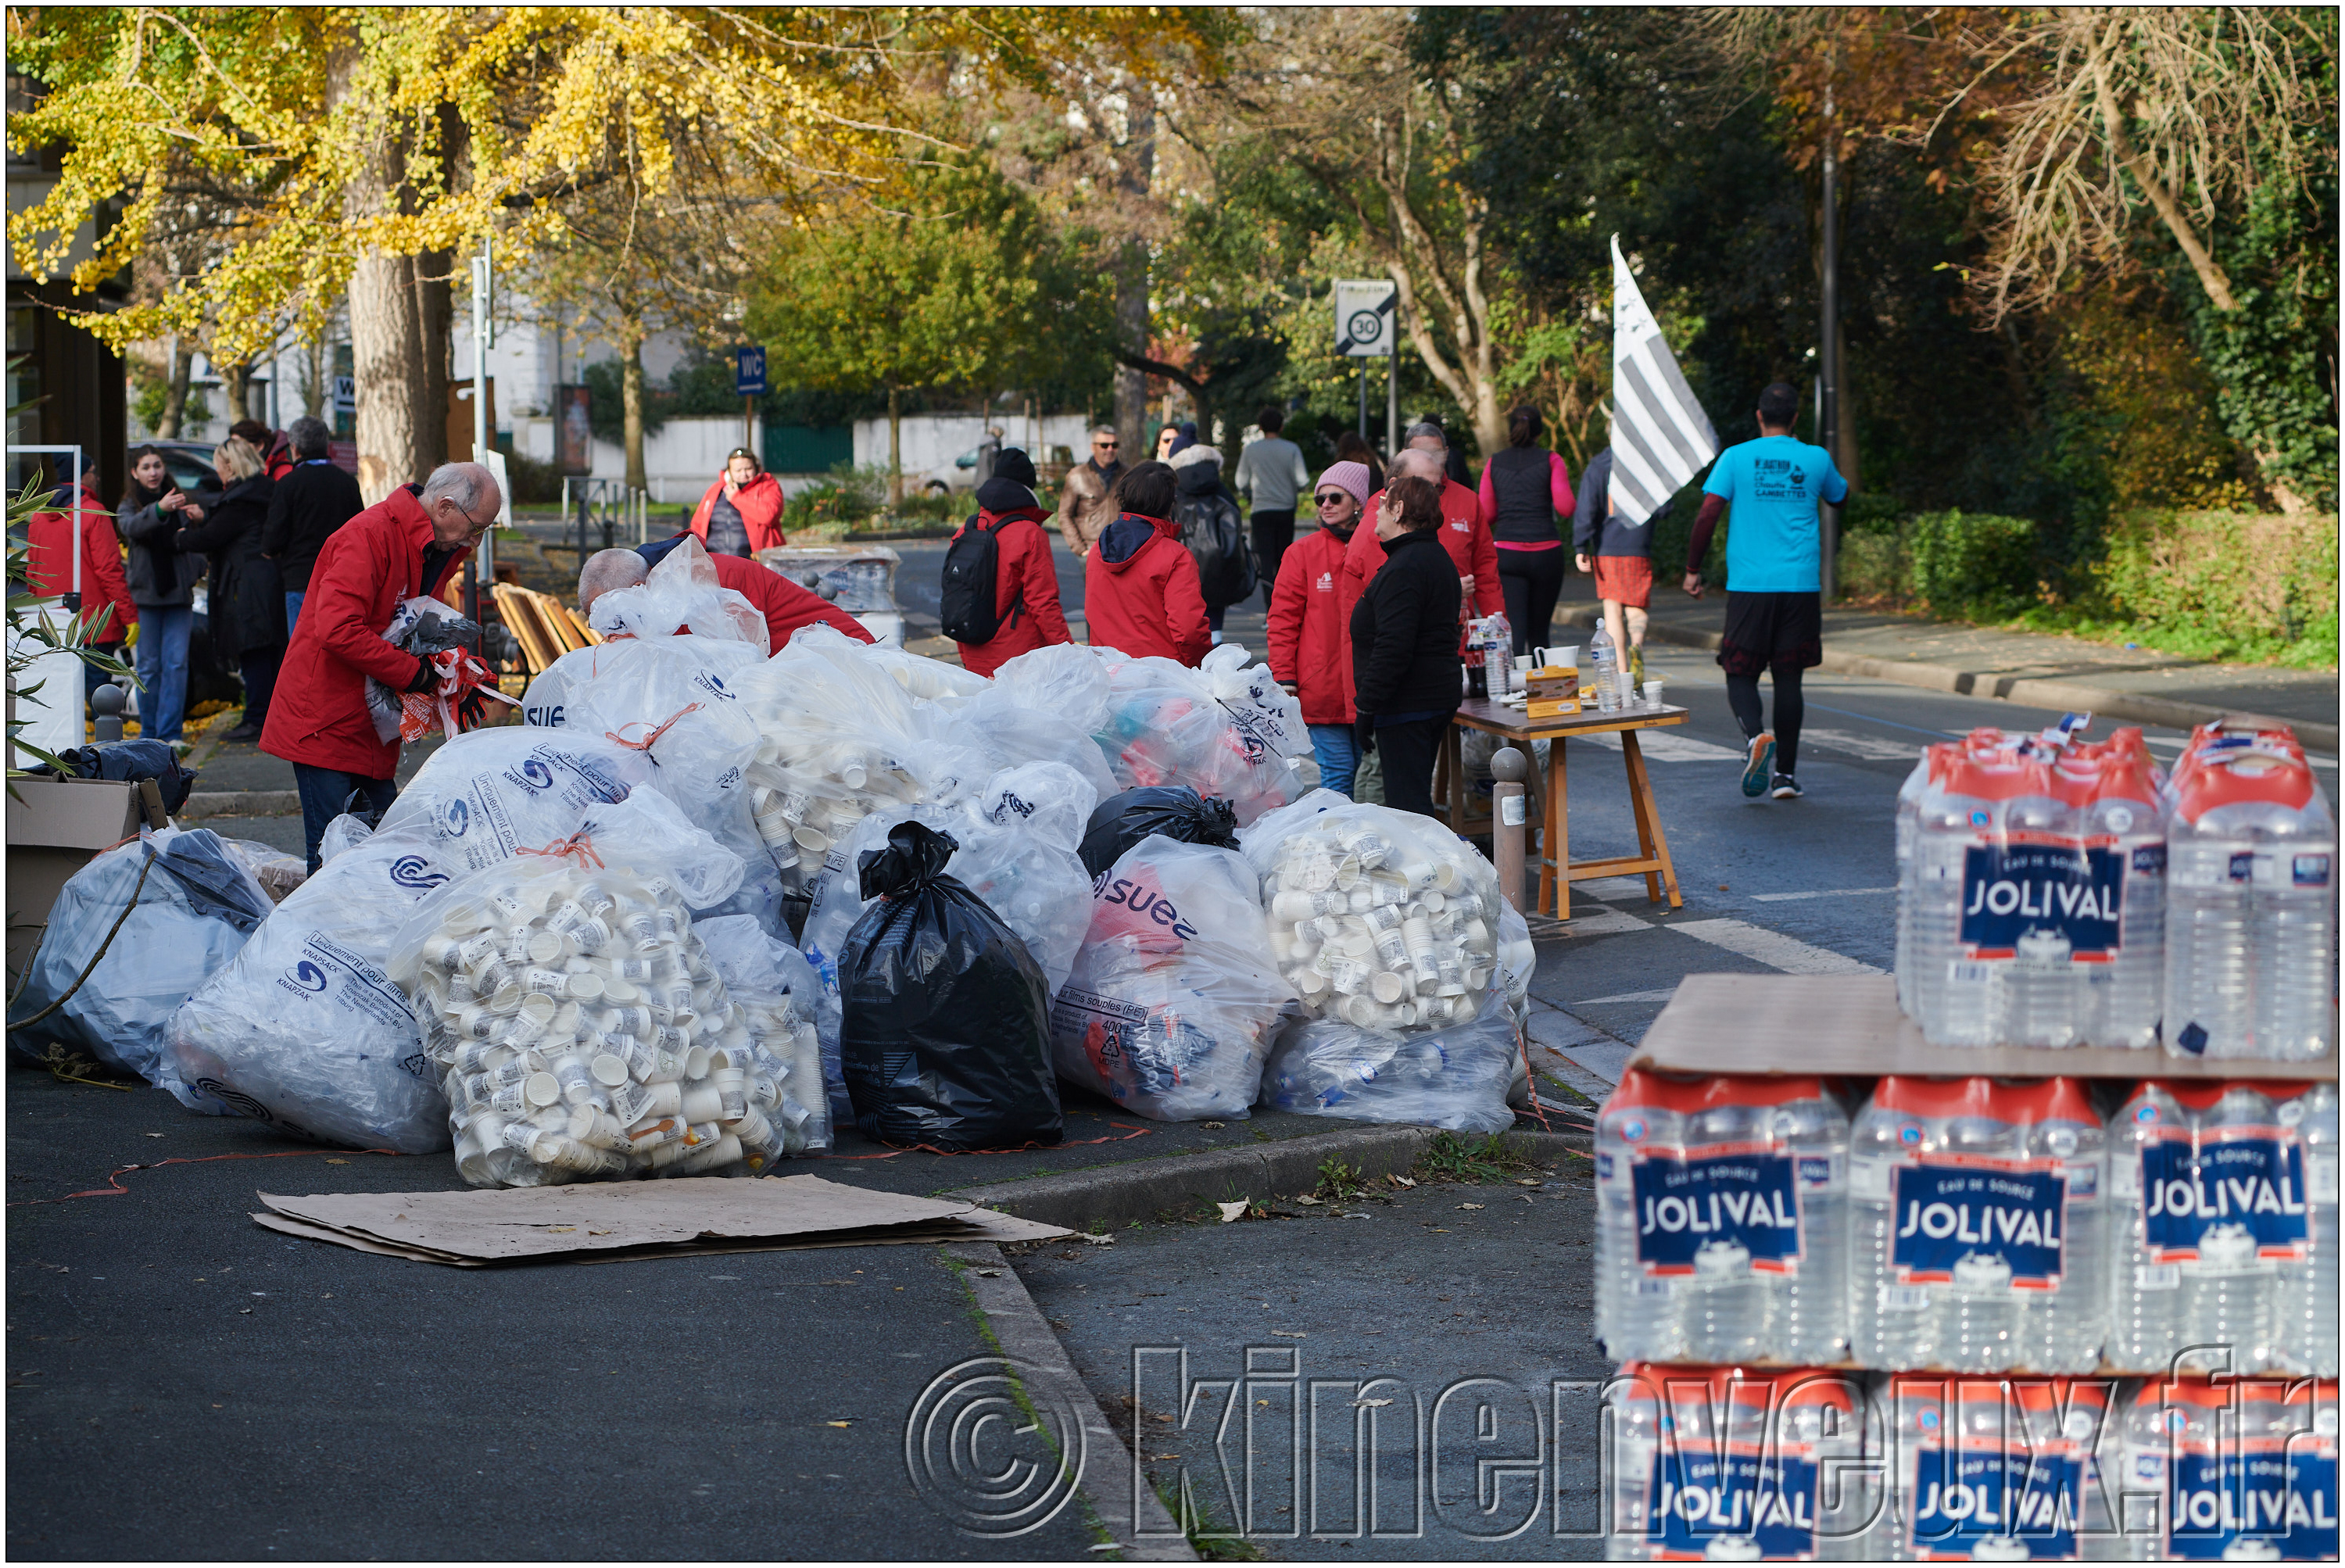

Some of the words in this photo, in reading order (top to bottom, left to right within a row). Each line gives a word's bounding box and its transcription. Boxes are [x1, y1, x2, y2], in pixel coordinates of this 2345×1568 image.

[1355, 319, 1376, 335] 30
[741, 354, 763, 378] WC
[502, 771, 539, 797] KNAPZAK
[585, 770, 609, 788] pour
[478, 773, 508, 829] Uniquement
[559, 793, 579, 811] Tilburg
[564, 787, 578, 798] The
[486, 836, 496, 850] This
[464, 846, 477, 870] Tilburg
[1104, 879, 1198, 942] suez
[1967, 879, 2119, 922] JOLIVAL
[276, 977, 310, 1002] KNAPZAK
[360, 965, 387, 987] pour
[383, 983, 408, 1004] films
[334, 993, 356, 1013] Tilburg
[339, 988, 352, 1001] The
[350, 997, 387, 1026] Netherlands
[344, 983, 370, 1005] Knapzak
[369, 1001, 395, 1022] Benelux
[392, 1018, 404, 1030] BV
[350, 977, 363, 992] This
[362, 986, 370, 994] is
[372, 995, 398, 1015] product
[395, 1010, 404, 1020] of
[1068, 990, 1086, 1004] films
[1087, 996, 1122, 1012] souples
[1122, 1003, 1147, 1021] (PE)
[1101, 1019, 1123, 1034] 400
[1107, 1044, 1113, 1052] 2
[1098, 1057, 1120, 1069] MDPE
[2214, 1148, 2267, 1168] SOURCE
[1707, 1165, 1759, 1183] SOURCE
[1936, 1177, 1965, 1195] EAU
[1967, 1178, 1985, 1192] DE
[1989, 1177, 2036, 1201] SOURCE
[2148, 1175, 2306, 1218] JOLIVAL
[1642, 1188, 1796, 1236] JOLIVAL
[1899, 1199, 2061, 1249] JOLIVAL
[1652, 1481, 1813, 1528] JOLIVAL
[1917, 1480, 2078, 1530] JOLIVAL
[2171, 1488, 2337, 1530] JOLIVAL
